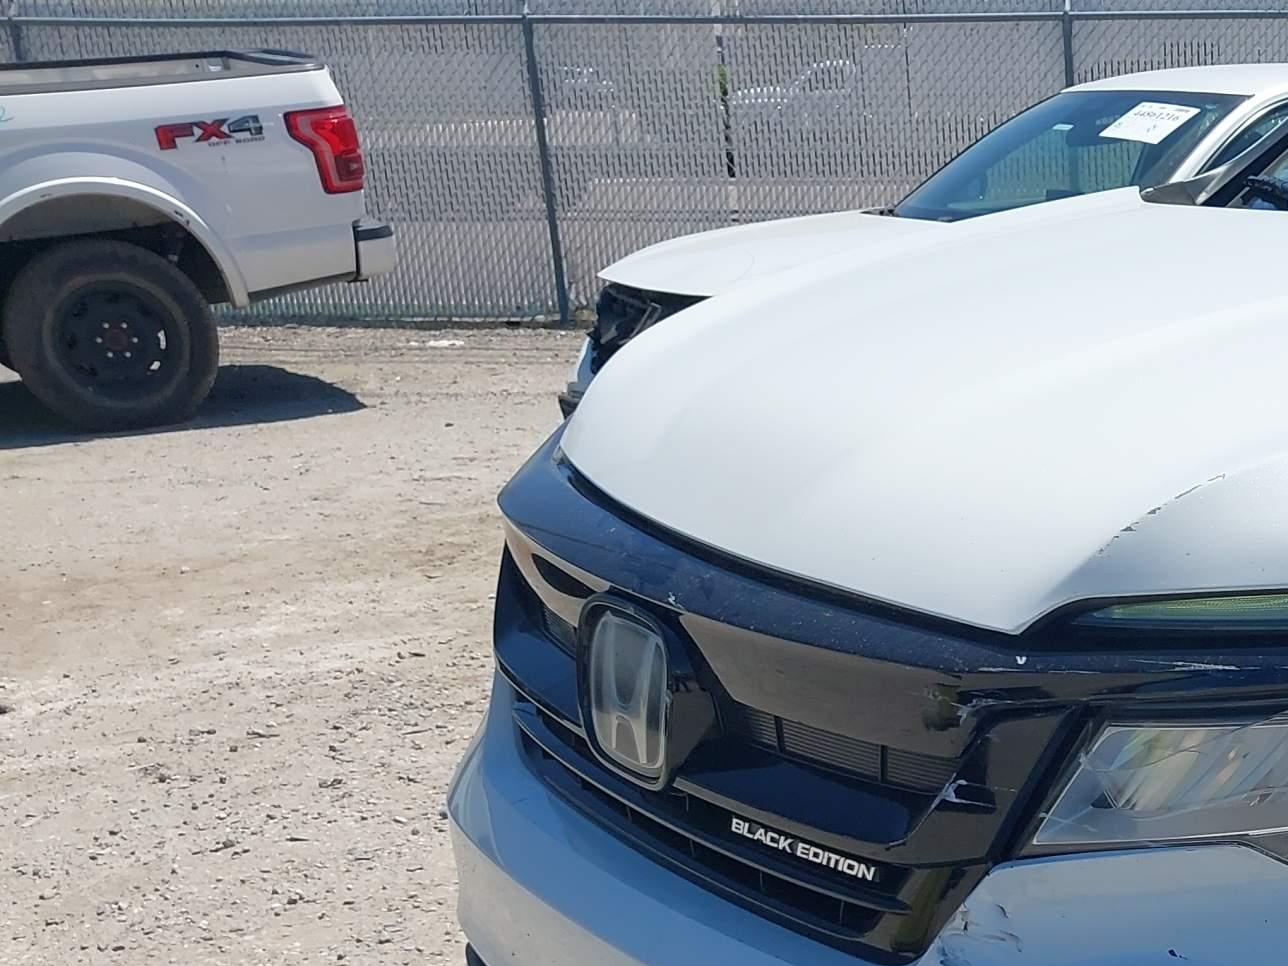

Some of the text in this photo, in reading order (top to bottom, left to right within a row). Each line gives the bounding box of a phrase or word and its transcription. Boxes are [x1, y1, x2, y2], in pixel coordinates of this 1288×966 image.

[154, 115, 264, 151] FX4
[235, 135, 266, 144] ROAD
[731, 817, 876, 881] BLACK EDITION
